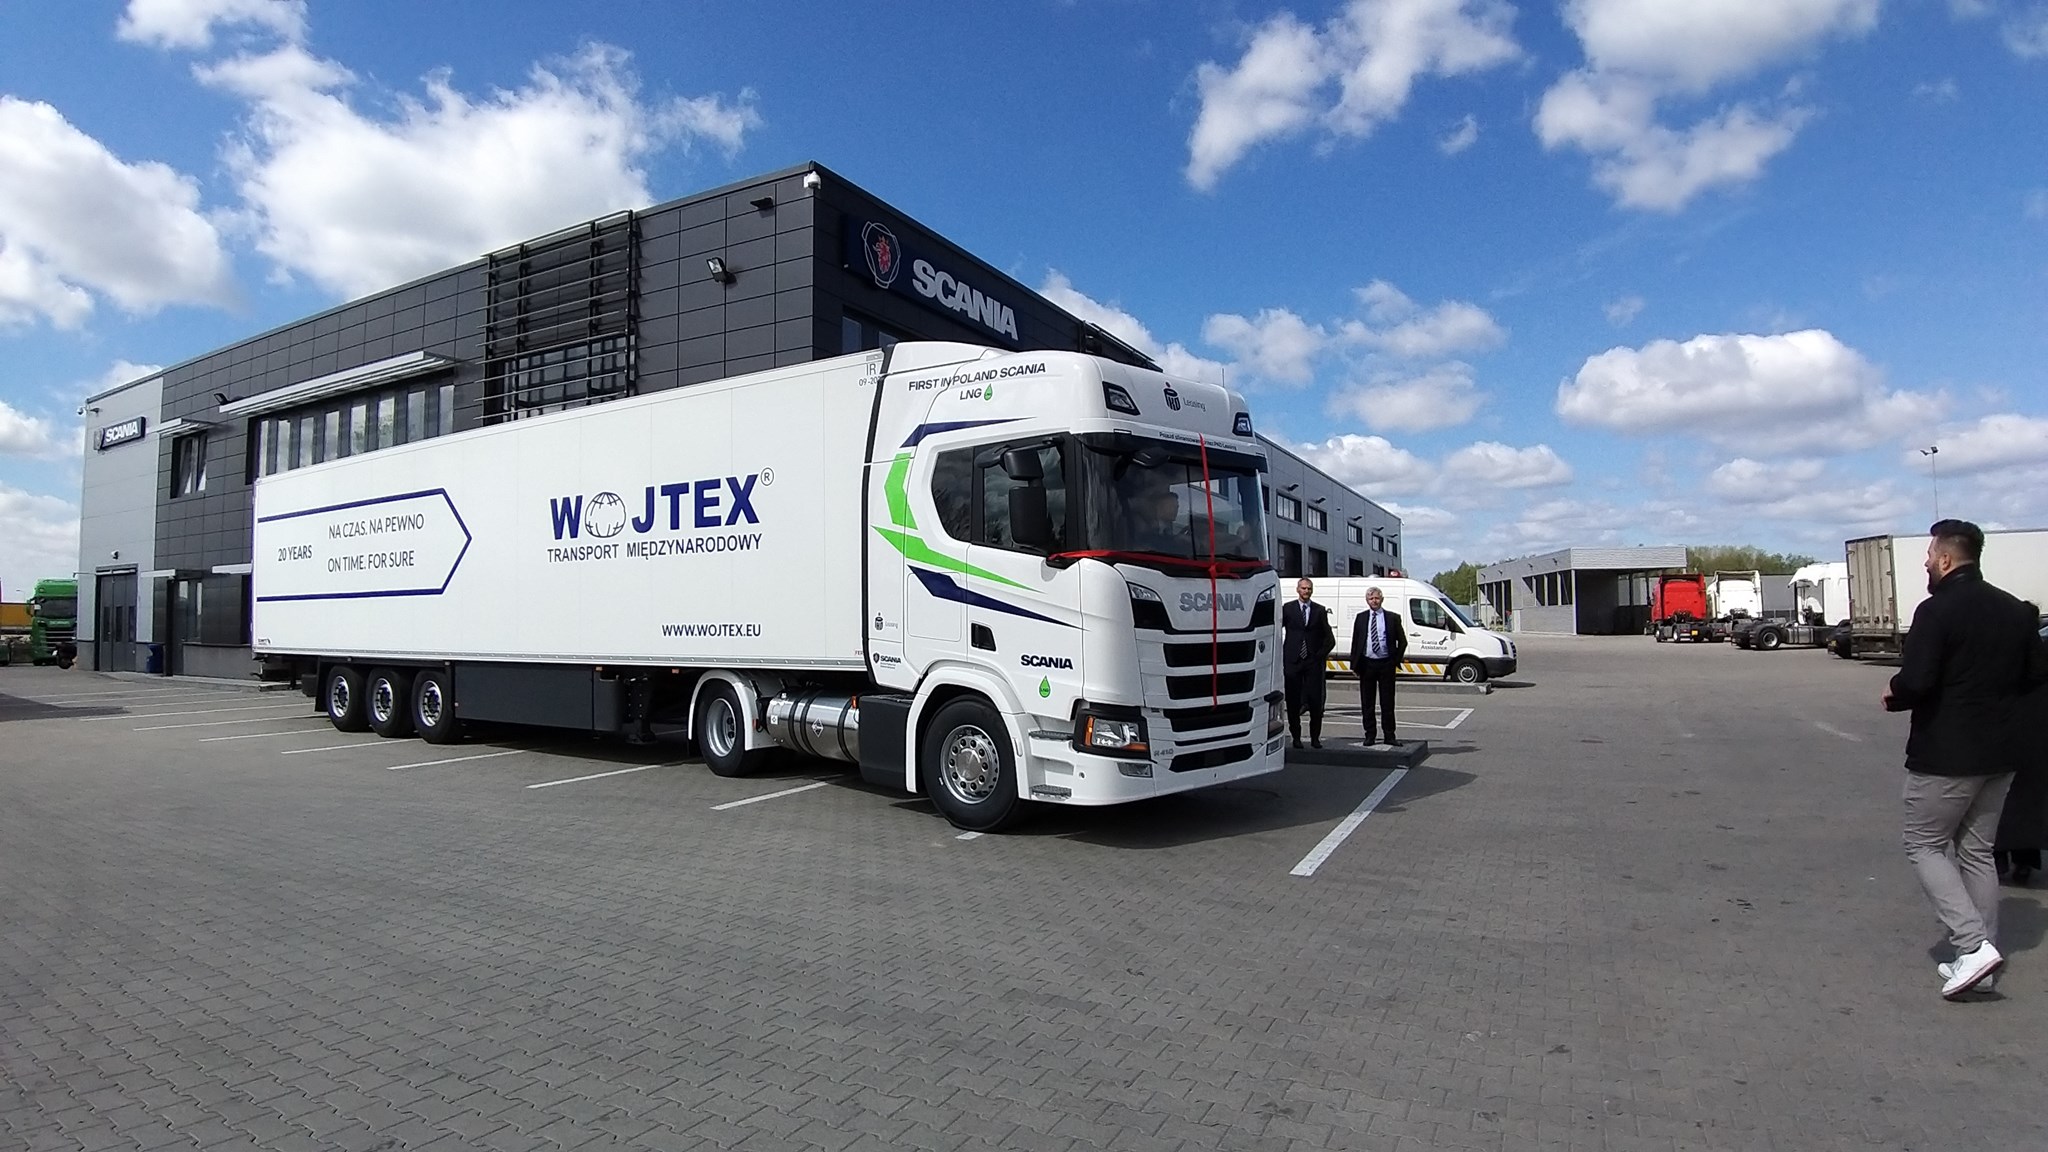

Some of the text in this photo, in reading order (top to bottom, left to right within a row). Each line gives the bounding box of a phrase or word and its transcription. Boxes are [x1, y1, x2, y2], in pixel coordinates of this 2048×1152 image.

[912, 259, 1018, 340] SCANIA
[908, 363, 1046, 391] FIRST IN POLAND SCANIA
[960, 388, 982, 400] LNG
[1183, 397, 1206, 412] Leasing
[106, 421, 138, 442] SCANIA
[328, 513, 425, 539] NA CZAS. NA PEWNO
[278, 545, 312, 561] 20 YEARS
[547, 533, 762, 563] TRANSPORT MIĘDZYNARODOWY
[328, 550, 415, 572] ON TIME. FOR SURE
[1179, 592, 1245, 611] SCANIA
[661, 624, 761, 637] WWW.WOJTEX.EU
[880, 655, 901, 664] SCANIA
[1021, 654, 1073, 670] SCANIA
